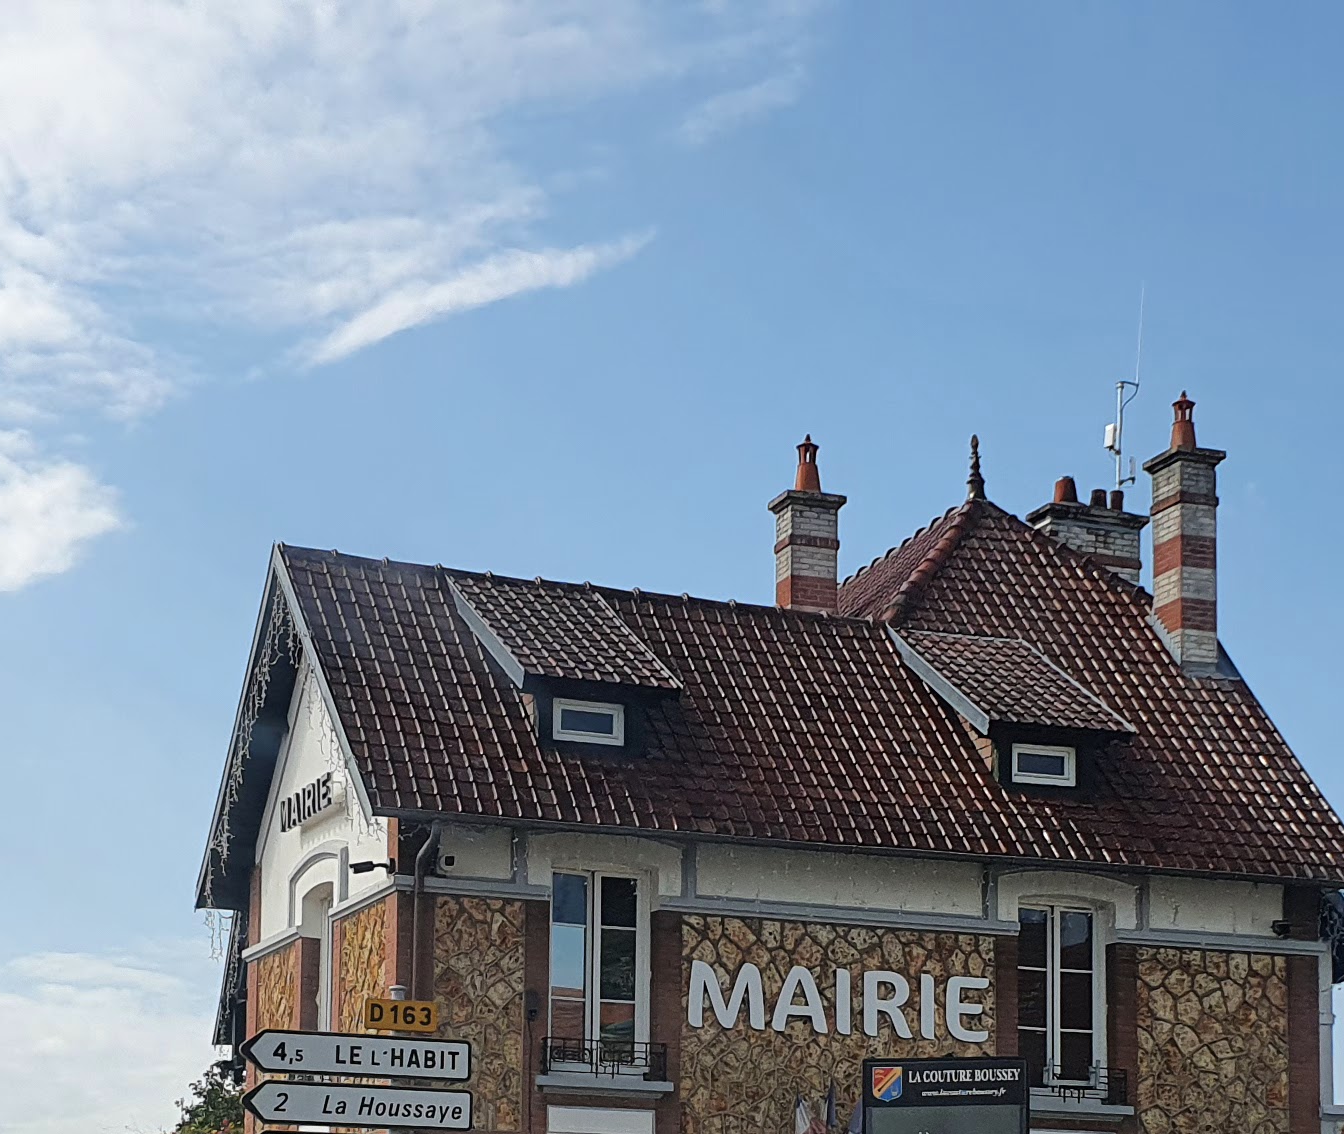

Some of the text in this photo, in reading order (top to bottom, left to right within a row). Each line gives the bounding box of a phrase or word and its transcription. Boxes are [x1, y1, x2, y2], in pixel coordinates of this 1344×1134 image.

[280, 771, 332, 832] MAIRIE
[687, 959, 990, 1042] MAIRIE
[272, 1042, 460, 1070] 4,5 LE L'HABIT
[909, 1068, 1020, 1083] LA COUTURE BOUSSEY
[273, 1093, 462, 1123] 2 La Houssaye
